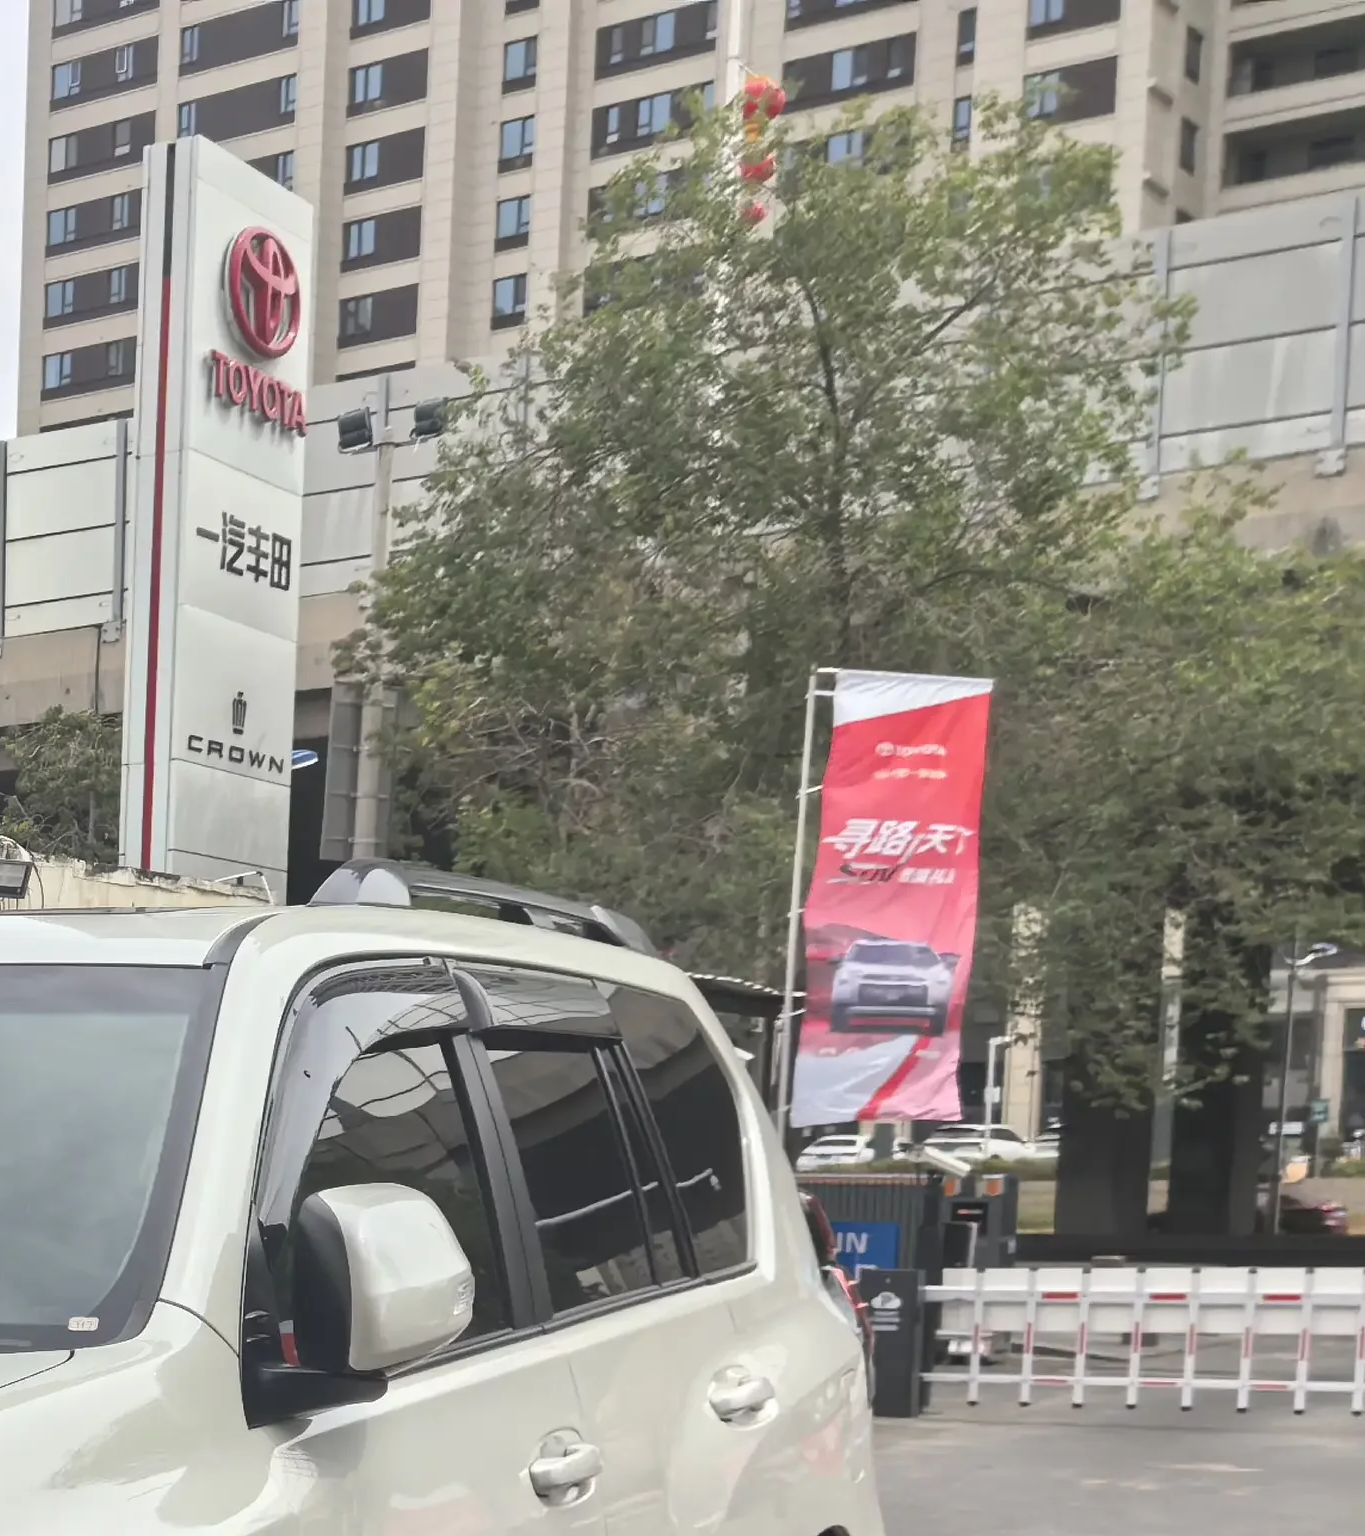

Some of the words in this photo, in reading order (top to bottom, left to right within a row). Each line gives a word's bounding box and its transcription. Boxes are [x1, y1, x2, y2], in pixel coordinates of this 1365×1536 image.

[209, 350, 308, 437] TOYOTA
[196, 511, 292, 591] 一汽丰田
[187, 734, 285, 774] CROWN
